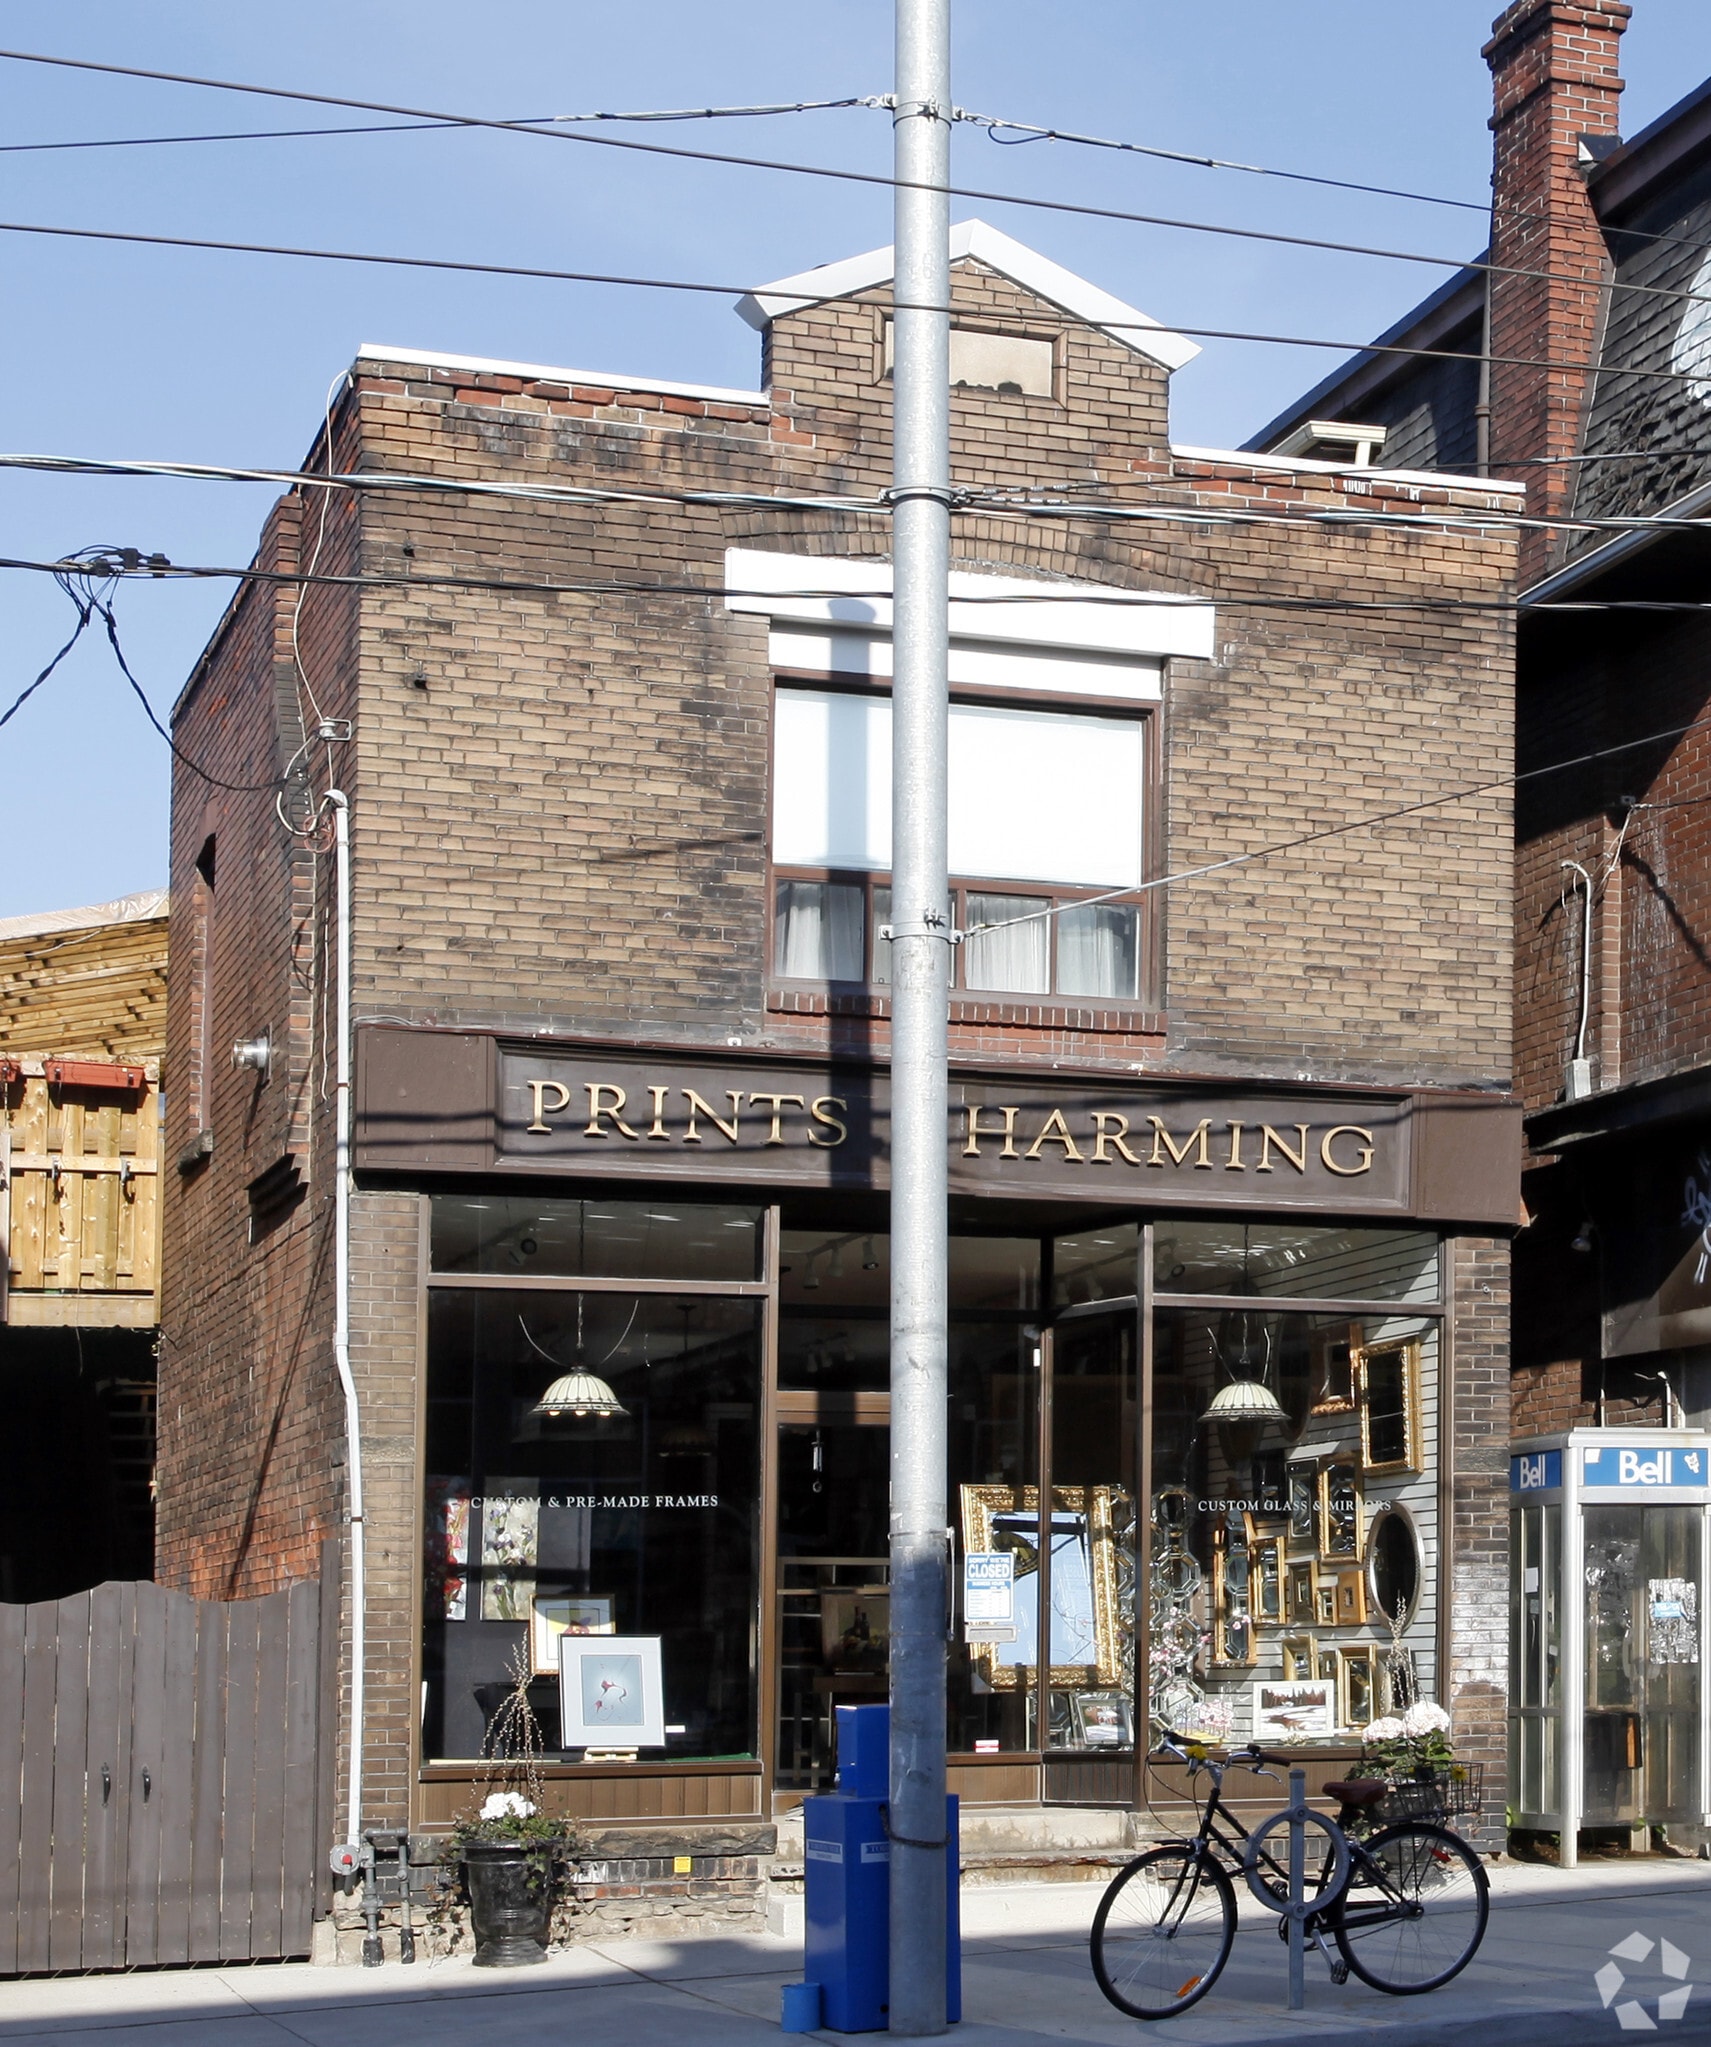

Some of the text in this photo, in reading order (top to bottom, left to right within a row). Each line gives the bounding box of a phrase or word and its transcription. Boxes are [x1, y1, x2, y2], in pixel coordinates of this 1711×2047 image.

[527, 1080, 1375, 1175] PRINTS HARMING
[1519, 1454, 1546, 1489] Bell
[1619, 1451, 1672, 1484] Bell
[471, 1495, 719, 1509] CUSTOM & PRE-MADE FRAMES
[1198, 1500, 1392, 1512] CUSTOM GLASS & MIRORS
[968, 1563, 1010, 1579] CLOSED
